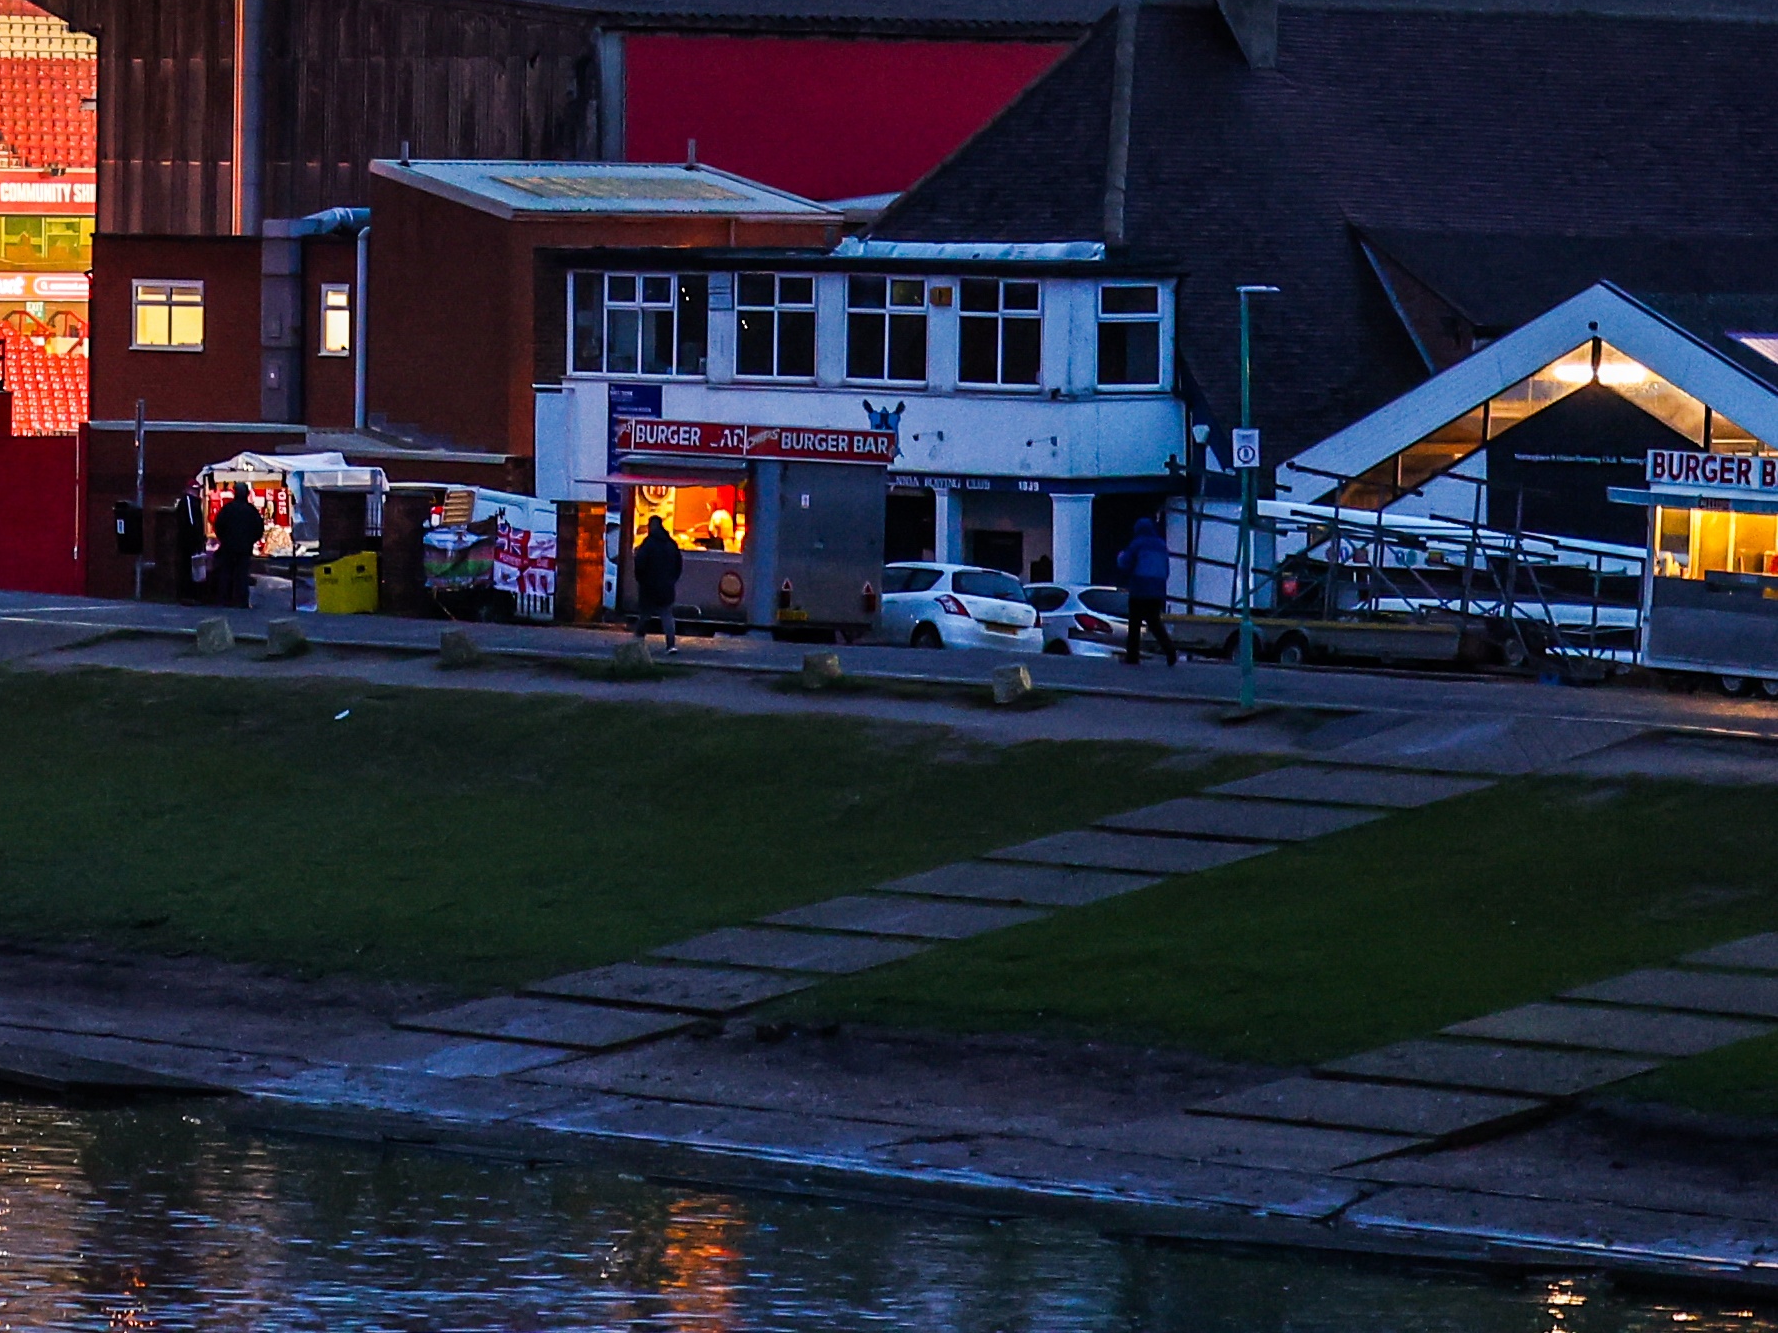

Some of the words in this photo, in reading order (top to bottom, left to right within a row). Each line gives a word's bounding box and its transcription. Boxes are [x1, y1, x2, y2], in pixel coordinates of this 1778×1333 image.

[0, 182, 72, 203] COMMUNITY
[635, 424, 701, 447] BURGER
[780, 432, 849, 453] BURGER
[853, 435, 889, 455] BAR
[1652, 452, 1752, 485] BURGER
